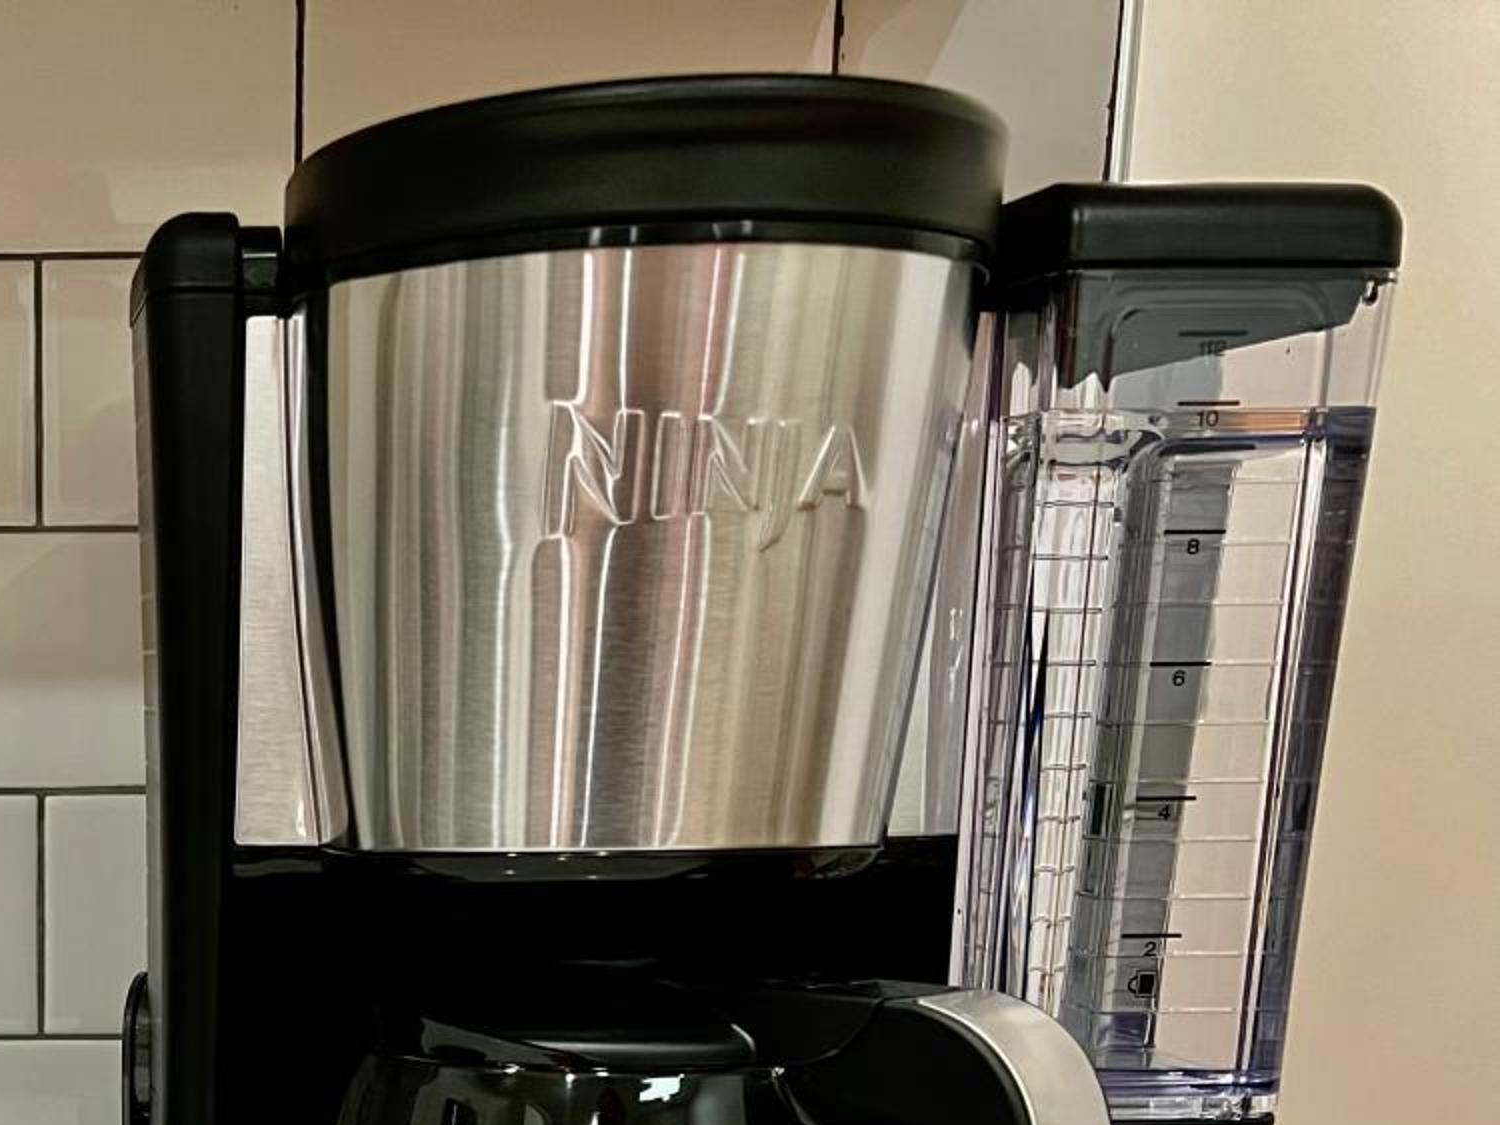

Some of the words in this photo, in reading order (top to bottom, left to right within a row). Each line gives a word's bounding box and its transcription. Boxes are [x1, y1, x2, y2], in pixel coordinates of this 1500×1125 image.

[1197, 410, 1219, 427] 10
[543, 400, 869, 553] NINJA
[1187, 539, 1200, 556] 8
[1172, 671, 1186, 687] 6
[1157, 805, 1171, 820] 4
[1144, 942, 1157, 957] 2
